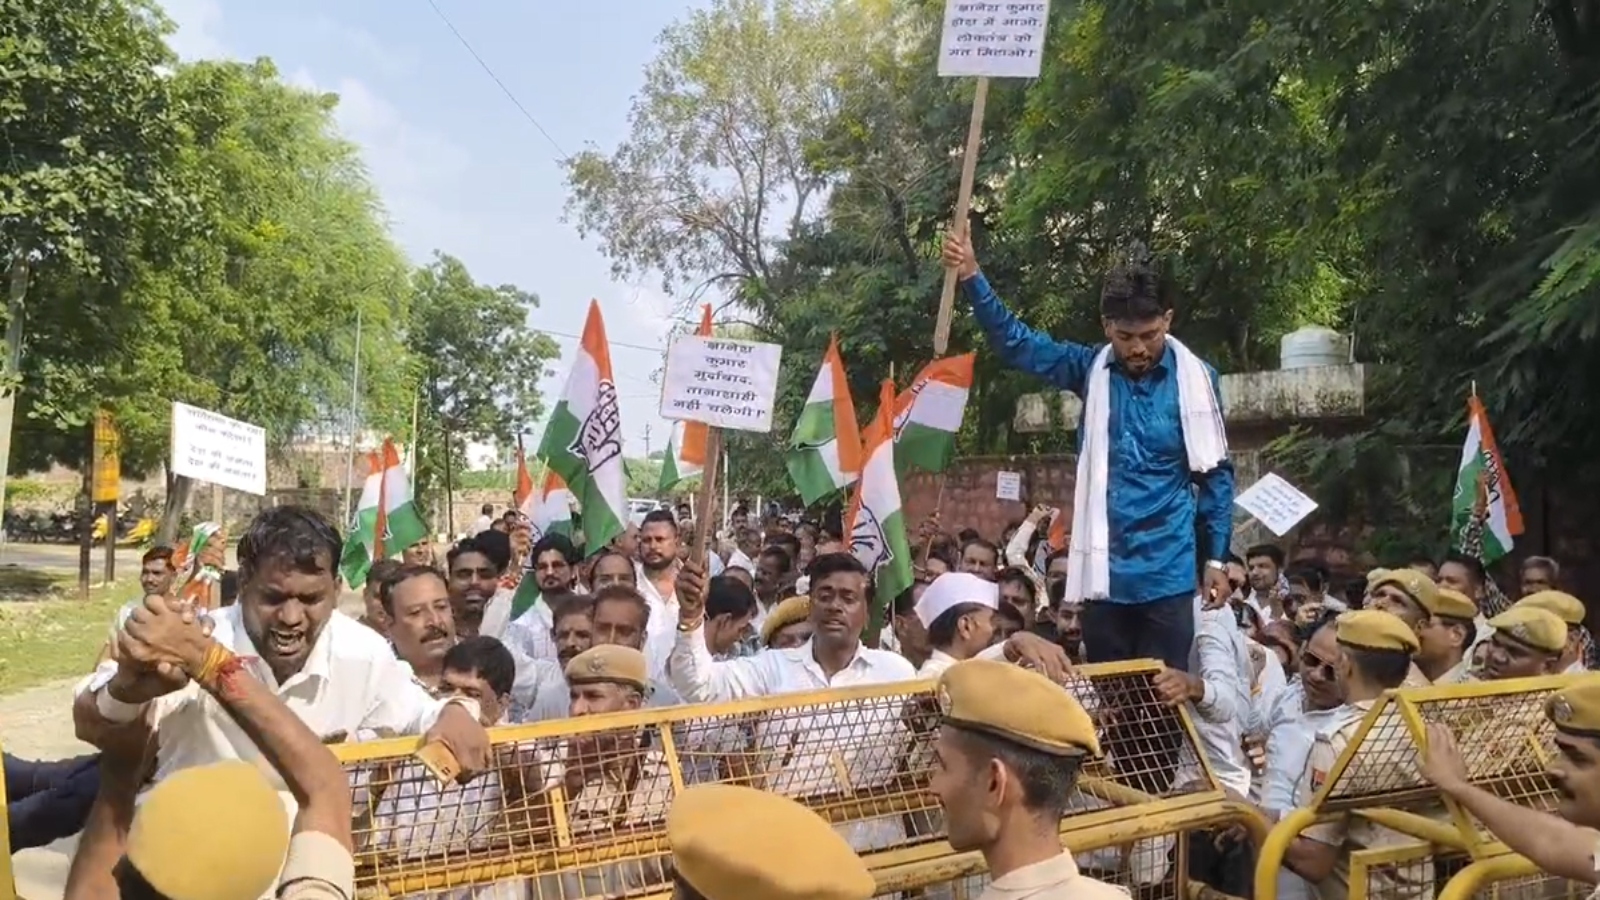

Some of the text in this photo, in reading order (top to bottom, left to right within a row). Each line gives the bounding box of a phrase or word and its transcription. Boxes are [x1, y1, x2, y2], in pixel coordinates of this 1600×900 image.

[1006, 4, 1045, 14] कुमार
[956, 32, 1032, 43] लोकतंत्र को
[948, 48, 971, 57] मत
[705, 356, 747, 368] कुमार
[686, 387, 757, 401] तानाशाही
